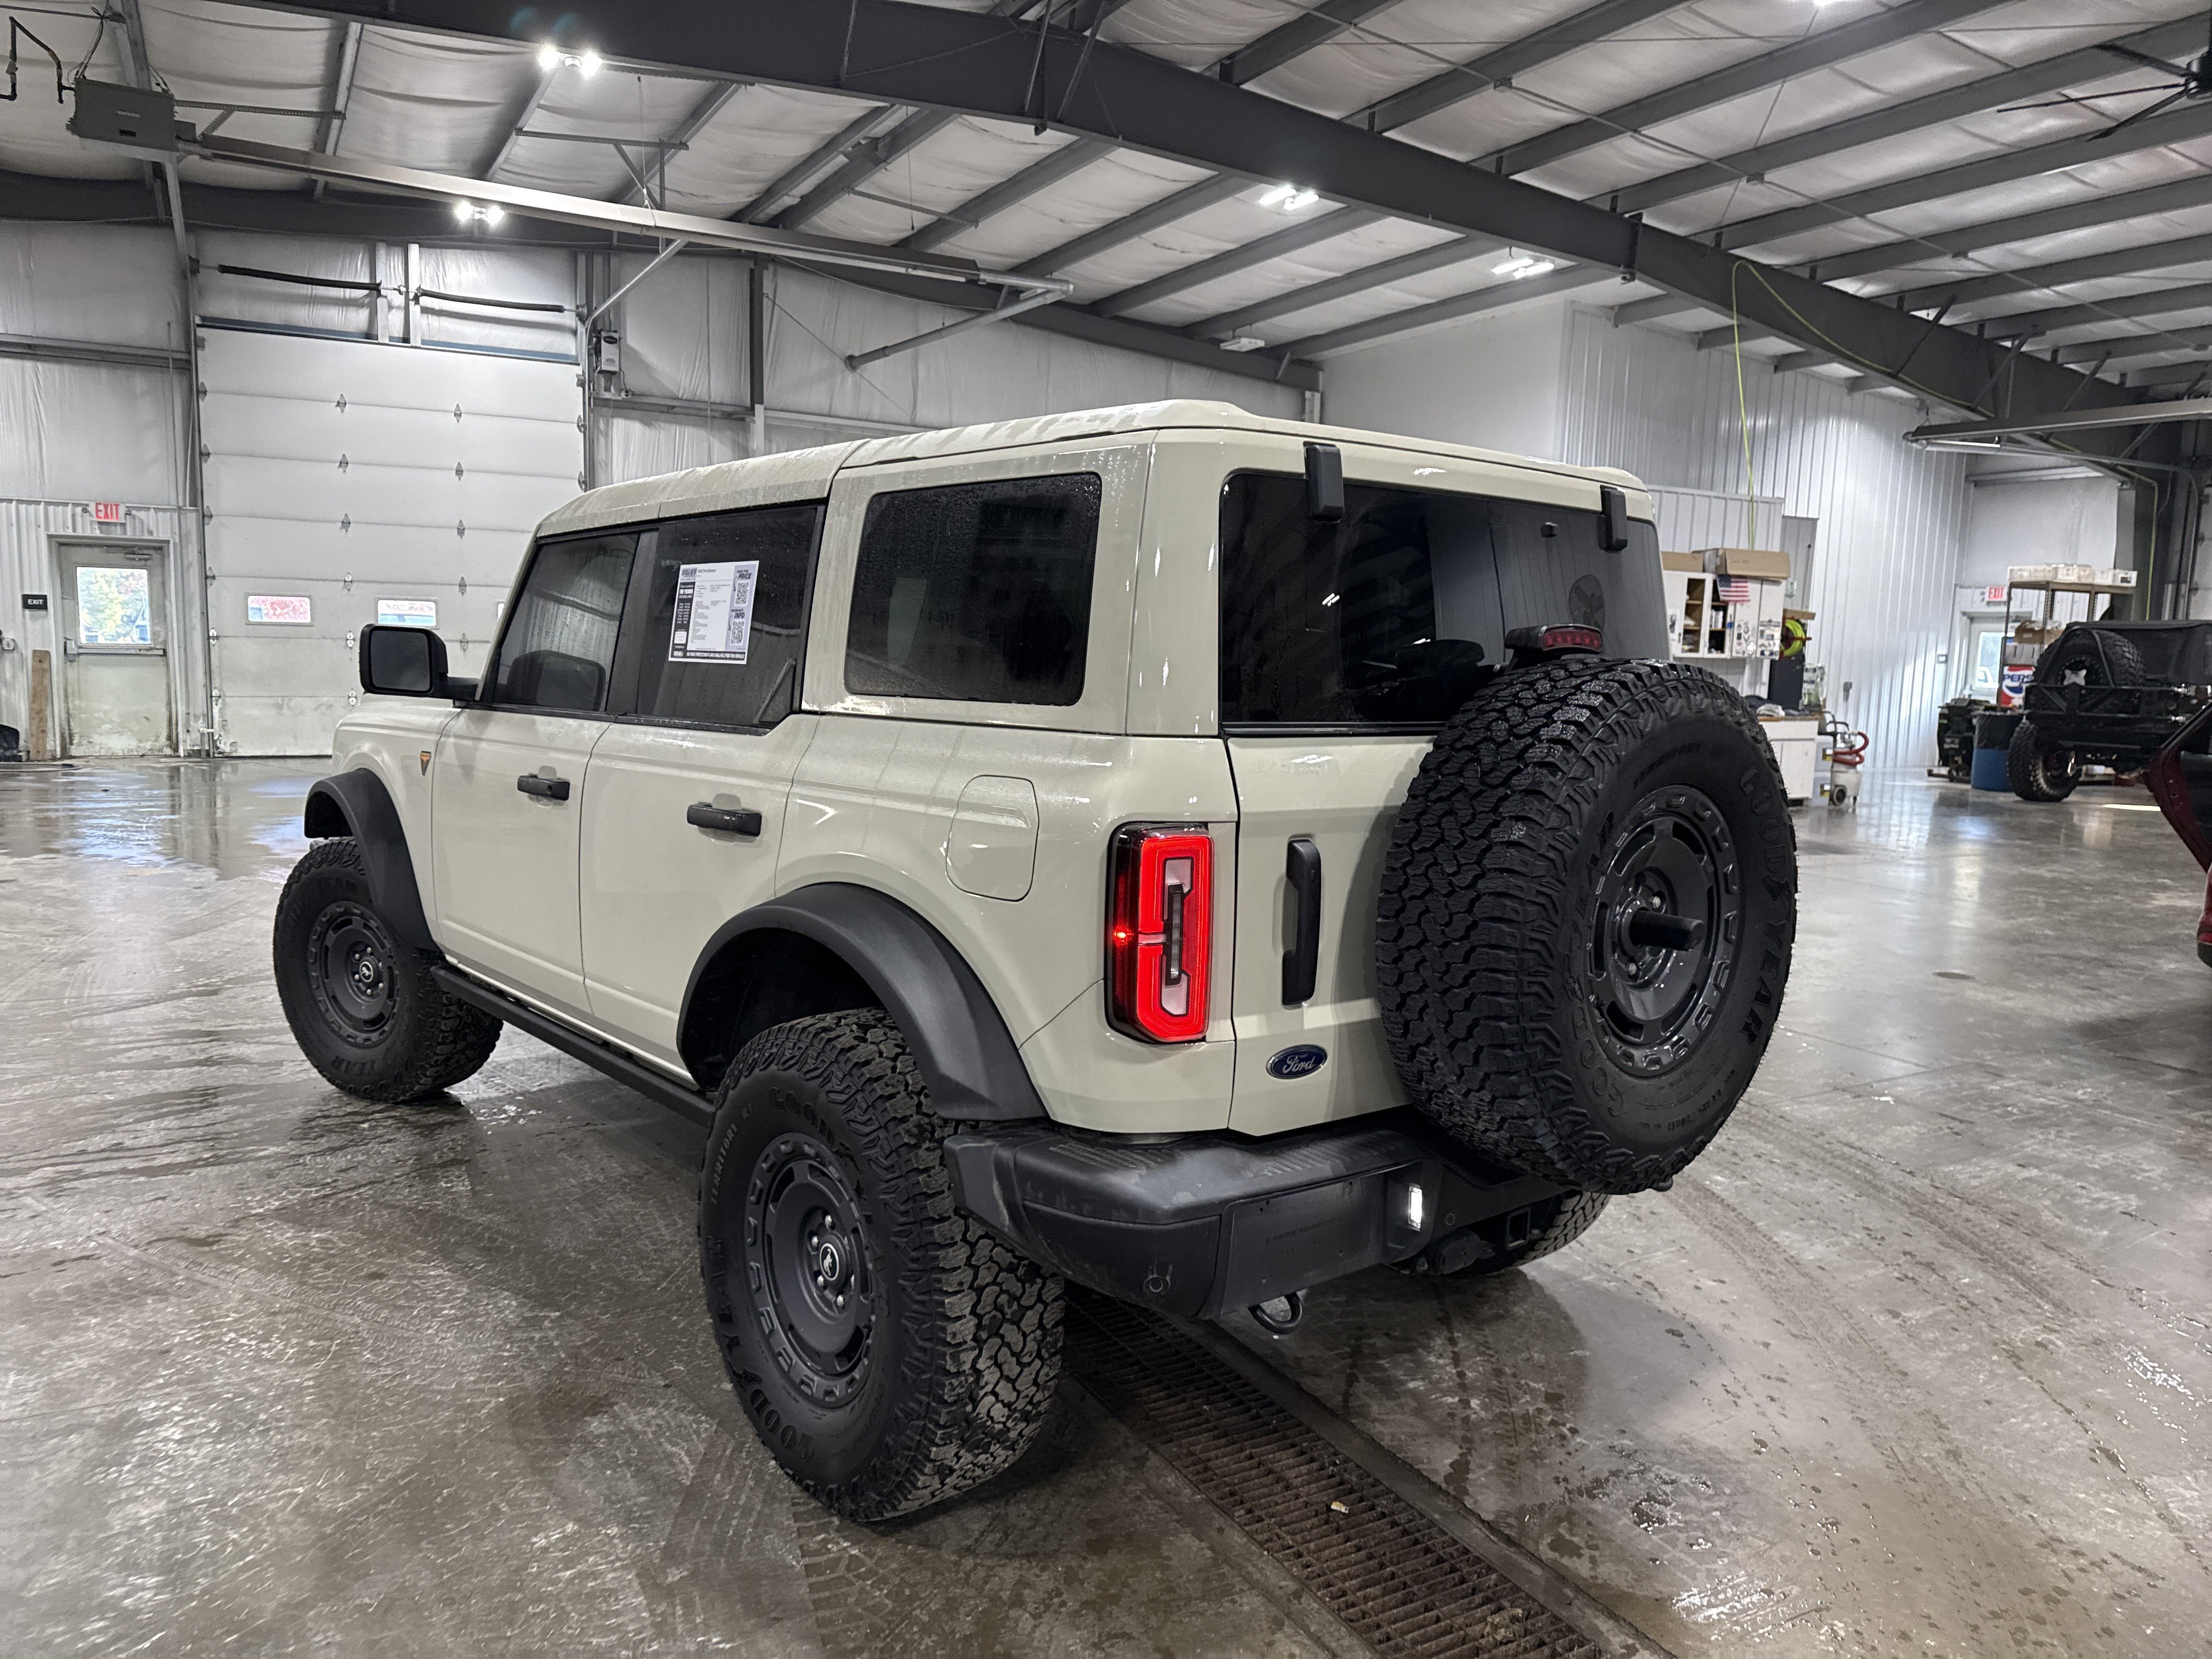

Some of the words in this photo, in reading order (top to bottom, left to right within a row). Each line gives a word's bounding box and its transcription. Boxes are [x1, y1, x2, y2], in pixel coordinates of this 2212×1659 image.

[95, 502, 120, 520] EXIT
[1988, 586, 2004, 599] EXIT
[1282, 1053, 1316, 1074] Ford
